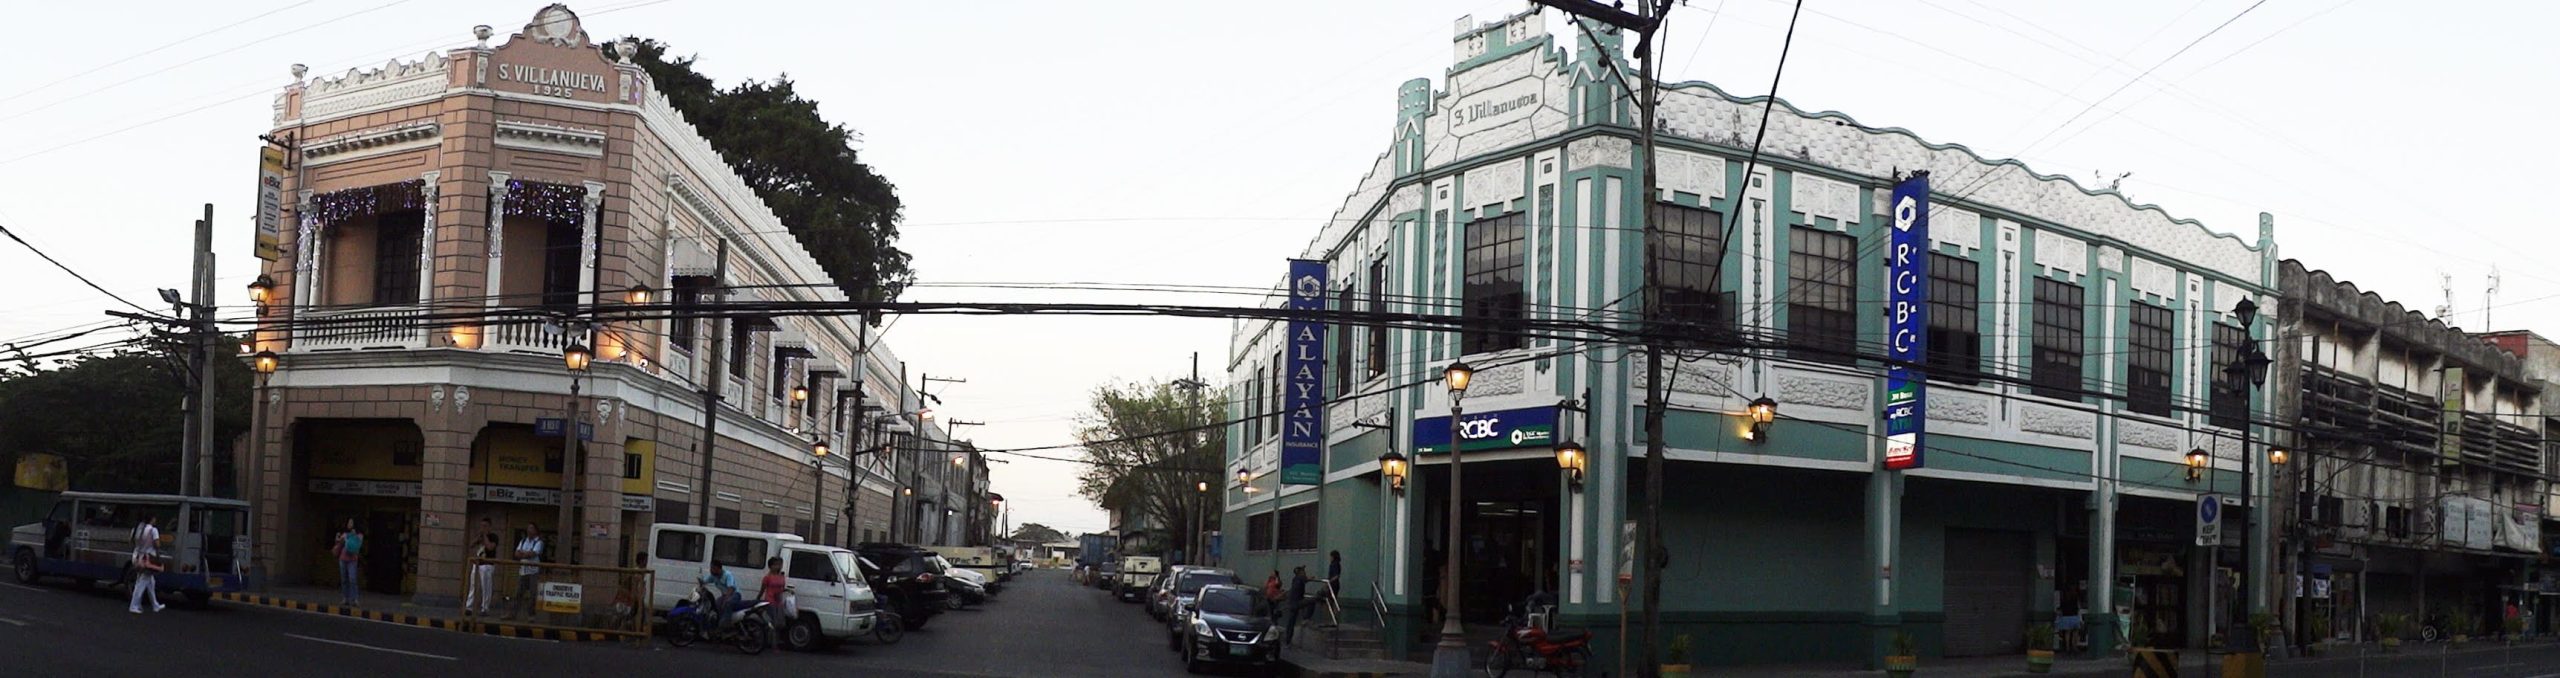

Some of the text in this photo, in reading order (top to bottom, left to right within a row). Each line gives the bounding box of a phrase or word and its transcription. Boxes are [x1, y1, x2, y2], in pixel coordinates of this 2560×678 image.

[498, 63, 606, 92] S. VILLANUEVA
[533, 84, 573, 98] 1925
[1468, 93, 1538, 123] Villanueva
[1894, 242, 1911, 354] RCBC
[489, 488, 515, 499] eBiz
